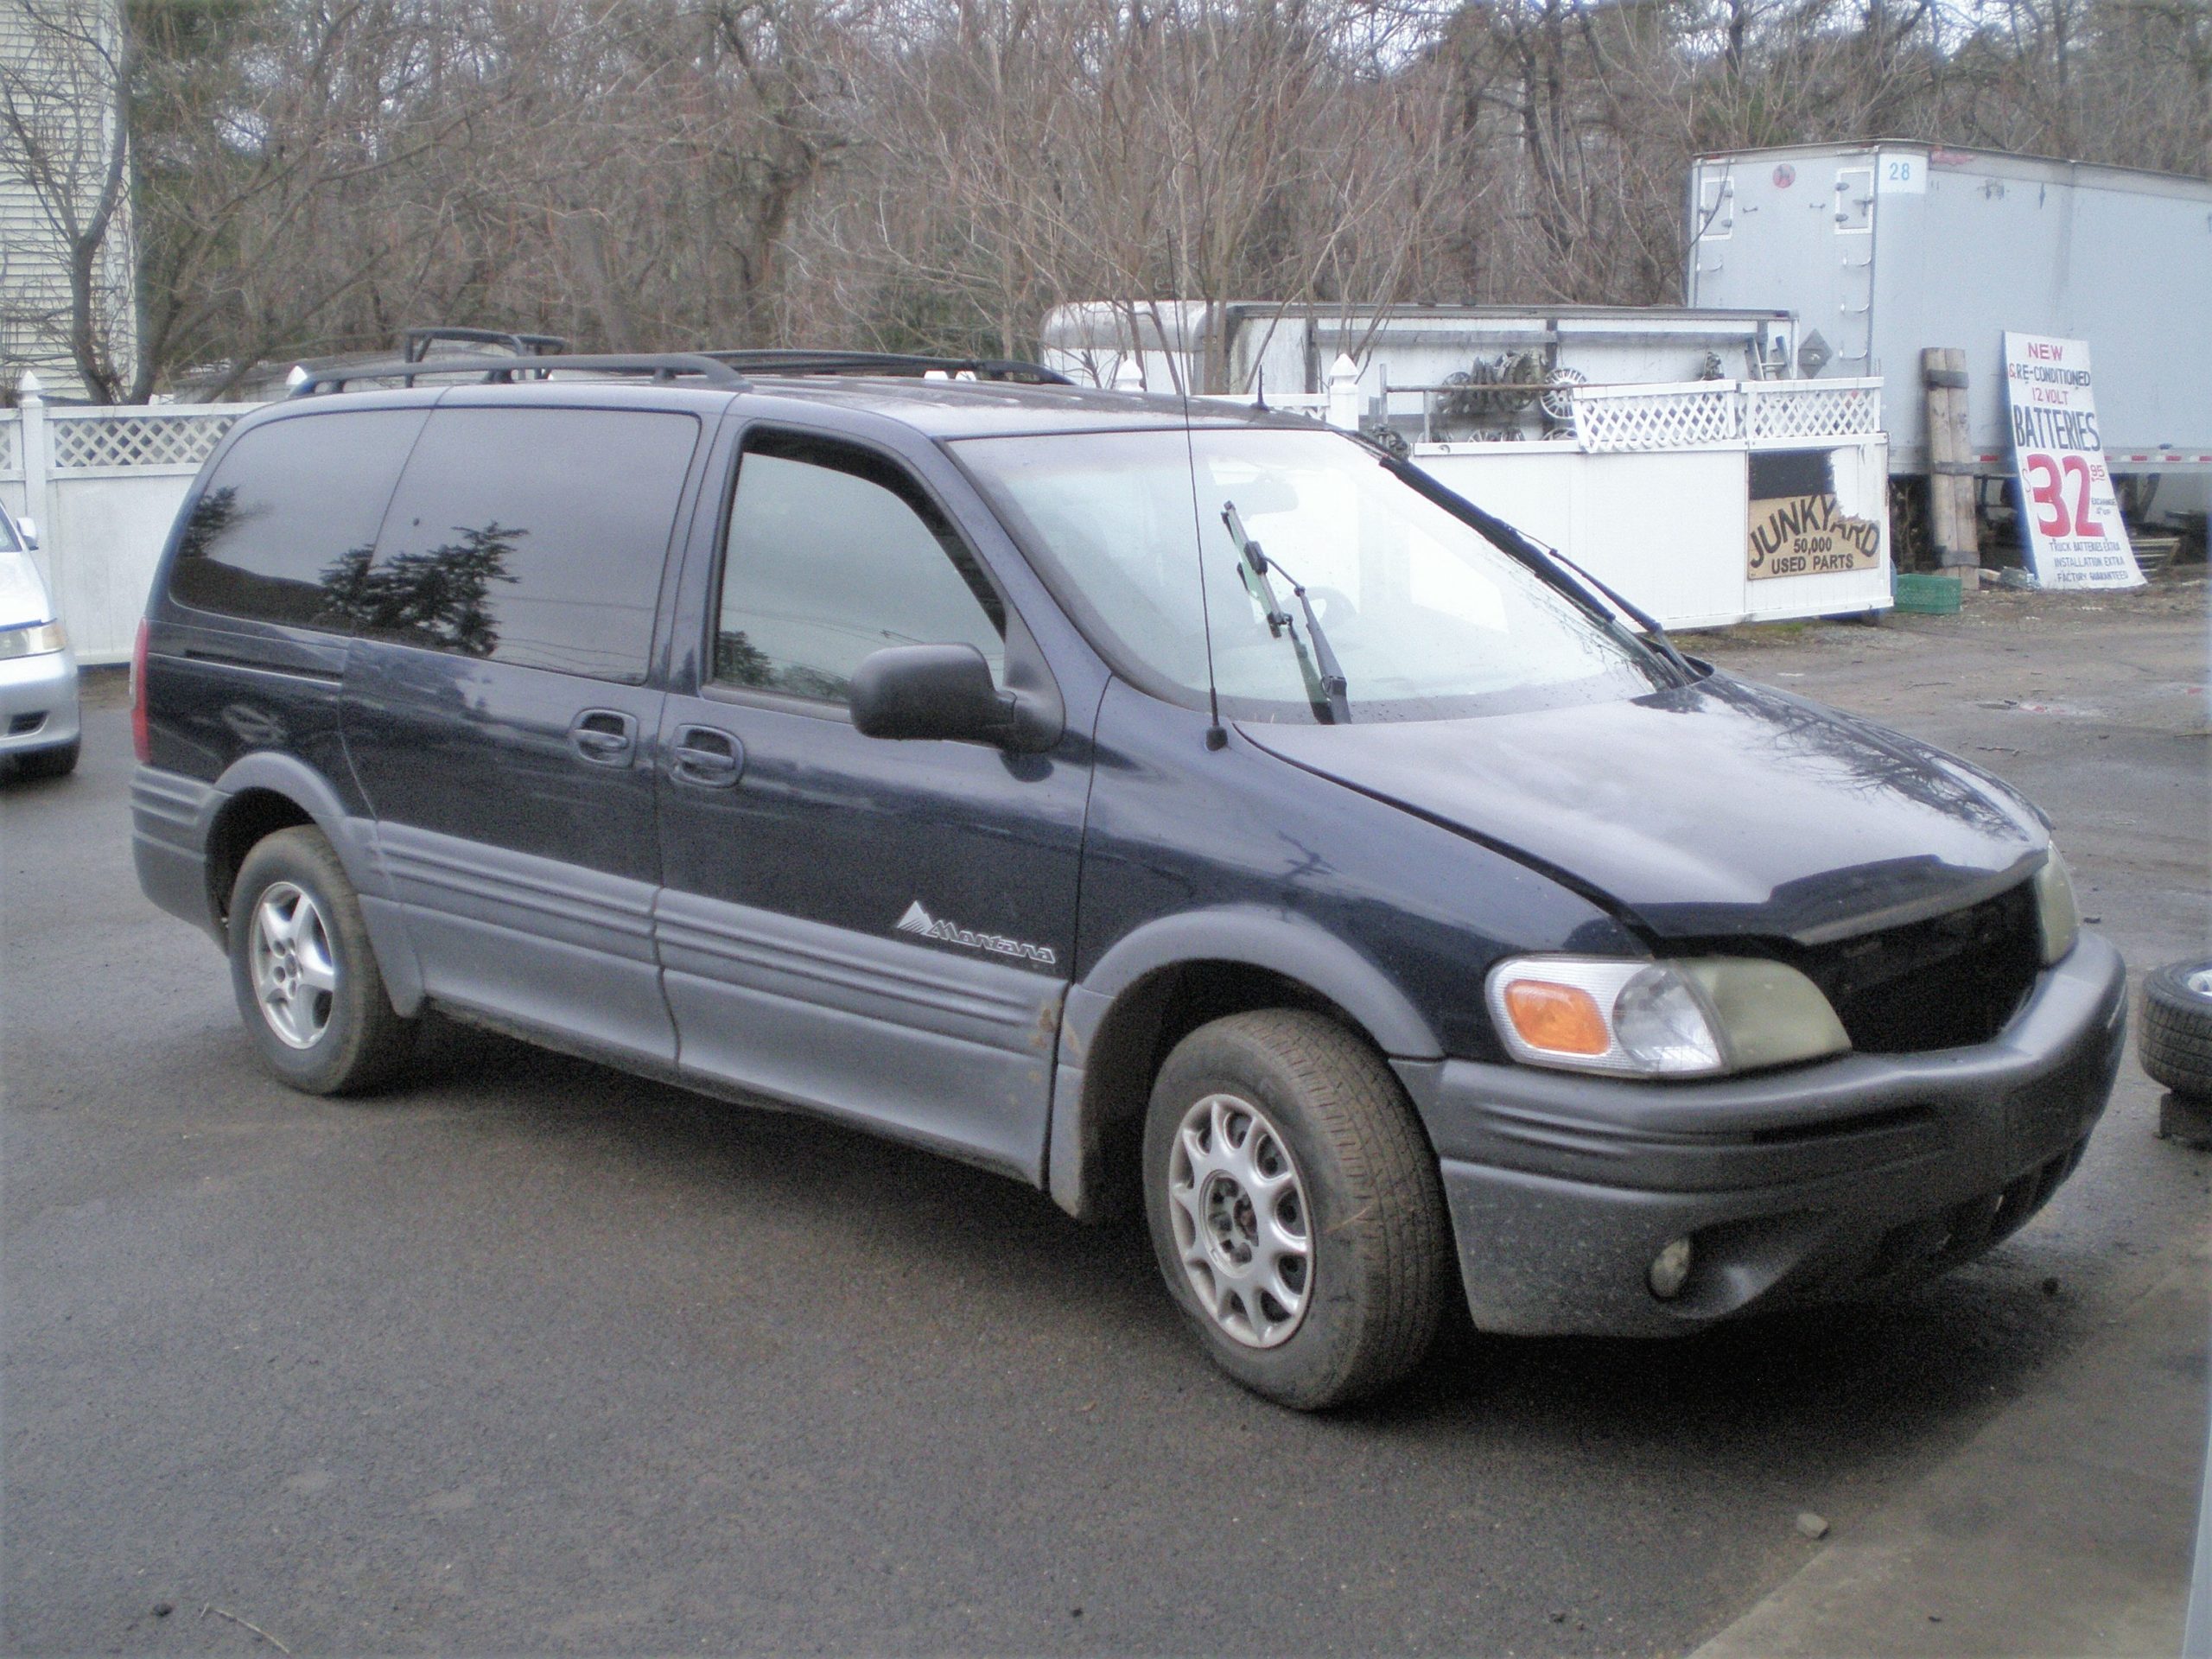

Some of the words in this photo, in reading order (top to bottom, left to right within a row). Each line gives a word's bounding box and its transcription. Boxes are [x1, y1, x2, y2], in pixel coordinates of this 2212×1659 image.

[1889, 162, 1910, 181] 28
[2027, 342, 2063, 361] NEW
[2031, 387, 2044, 402] 12
[2044, 389, 2069, 405] VOLT
[2013, 404, 2101, 452] BATTERIES
[2090, 464, 2105, 477] 95
[1793, 537, 1832, 555] 50,000
[2049, 541, 2071, 552] TRUCK
[1771, 556, 1806, 575] USED
[1813, 553, 1854, 571] PARTS
[2054, 556, 2102, 568] INSTALLATION
[2103, 556, 2125, 567] EXTRA
[925, 919, 1057, 964] Montana
